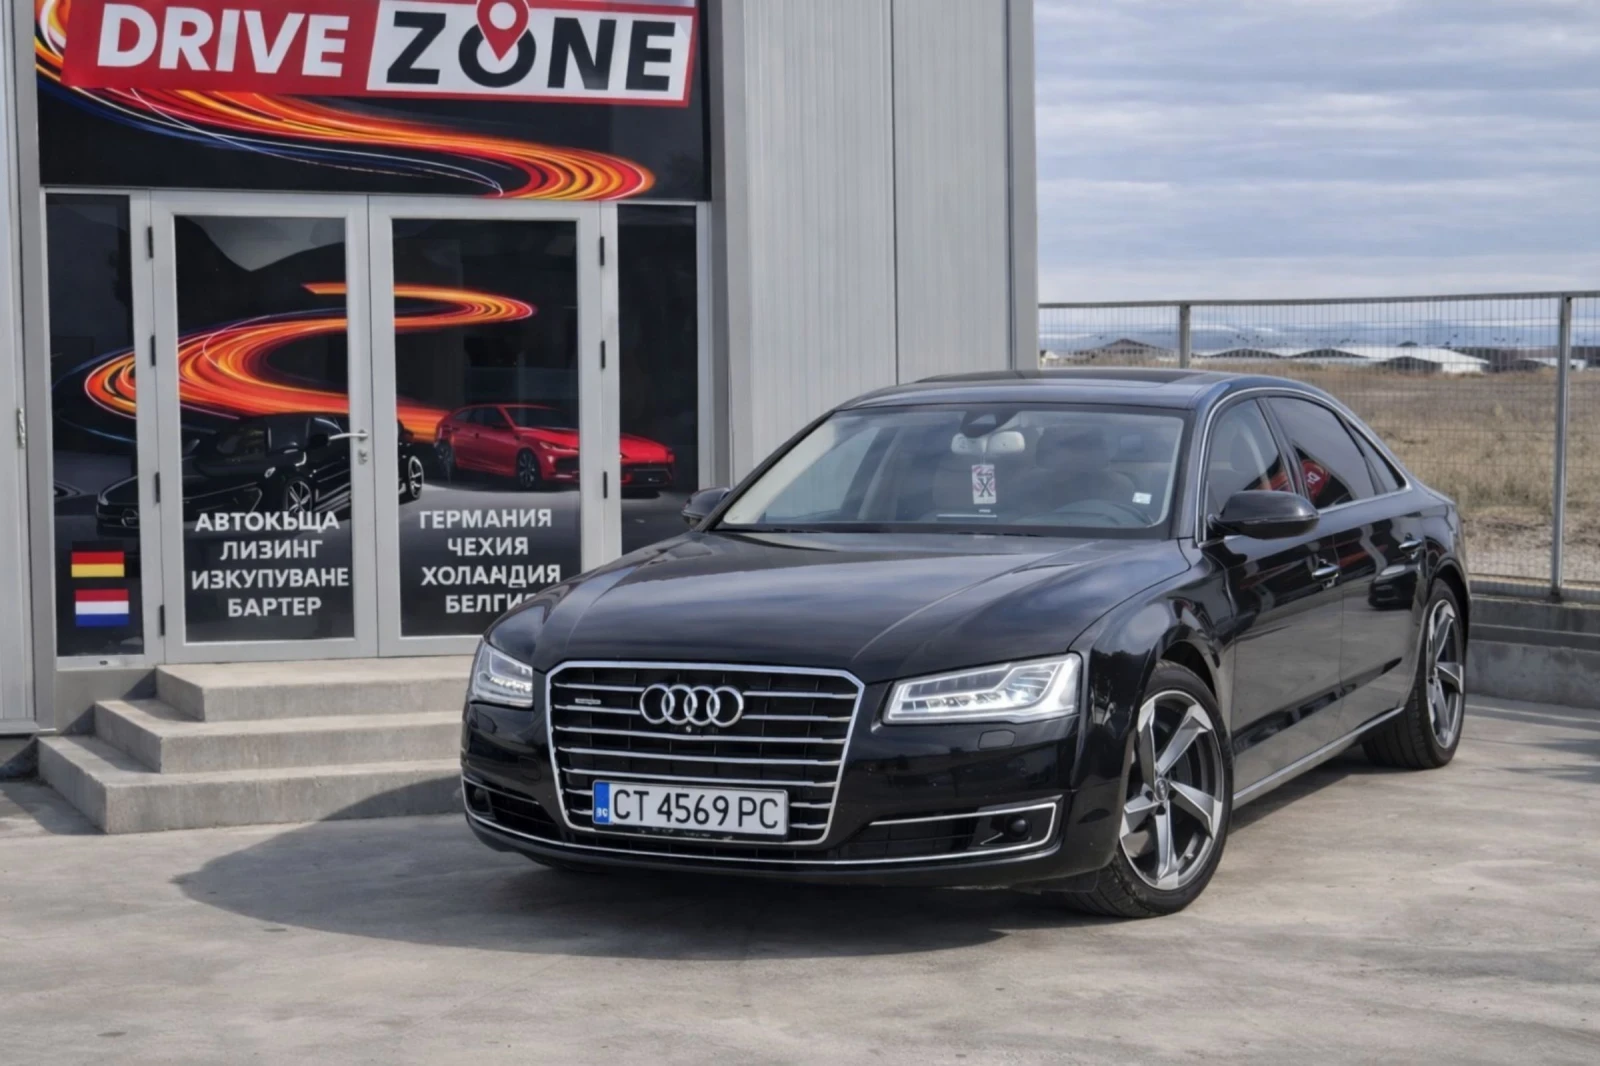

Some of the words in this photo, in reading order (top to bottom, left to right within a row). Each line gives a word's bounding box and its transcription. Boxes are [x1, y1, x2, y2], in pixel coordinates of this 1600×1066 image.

[97, 3, 349, 77] DRIVE
[386, 10, 676, 92] ZONE
[419, 508, 552, 530] ГЕРМАНИЯ
[219, 539, 323, 561] ЛИЗИНГ
[447, 536, 528, 557] ЧЕХИЯ
[191, 567, 350, 590] ИЗКУПУВАНЕ
[420, 564, 561, 589] ХОЛАНДИЯ
[227, 596, 322, 618] БАРТЕР
[613, 789, 650, 822] CT
[657, 792, 730, 826] 4569
[738, 796, 779, 829] PC
